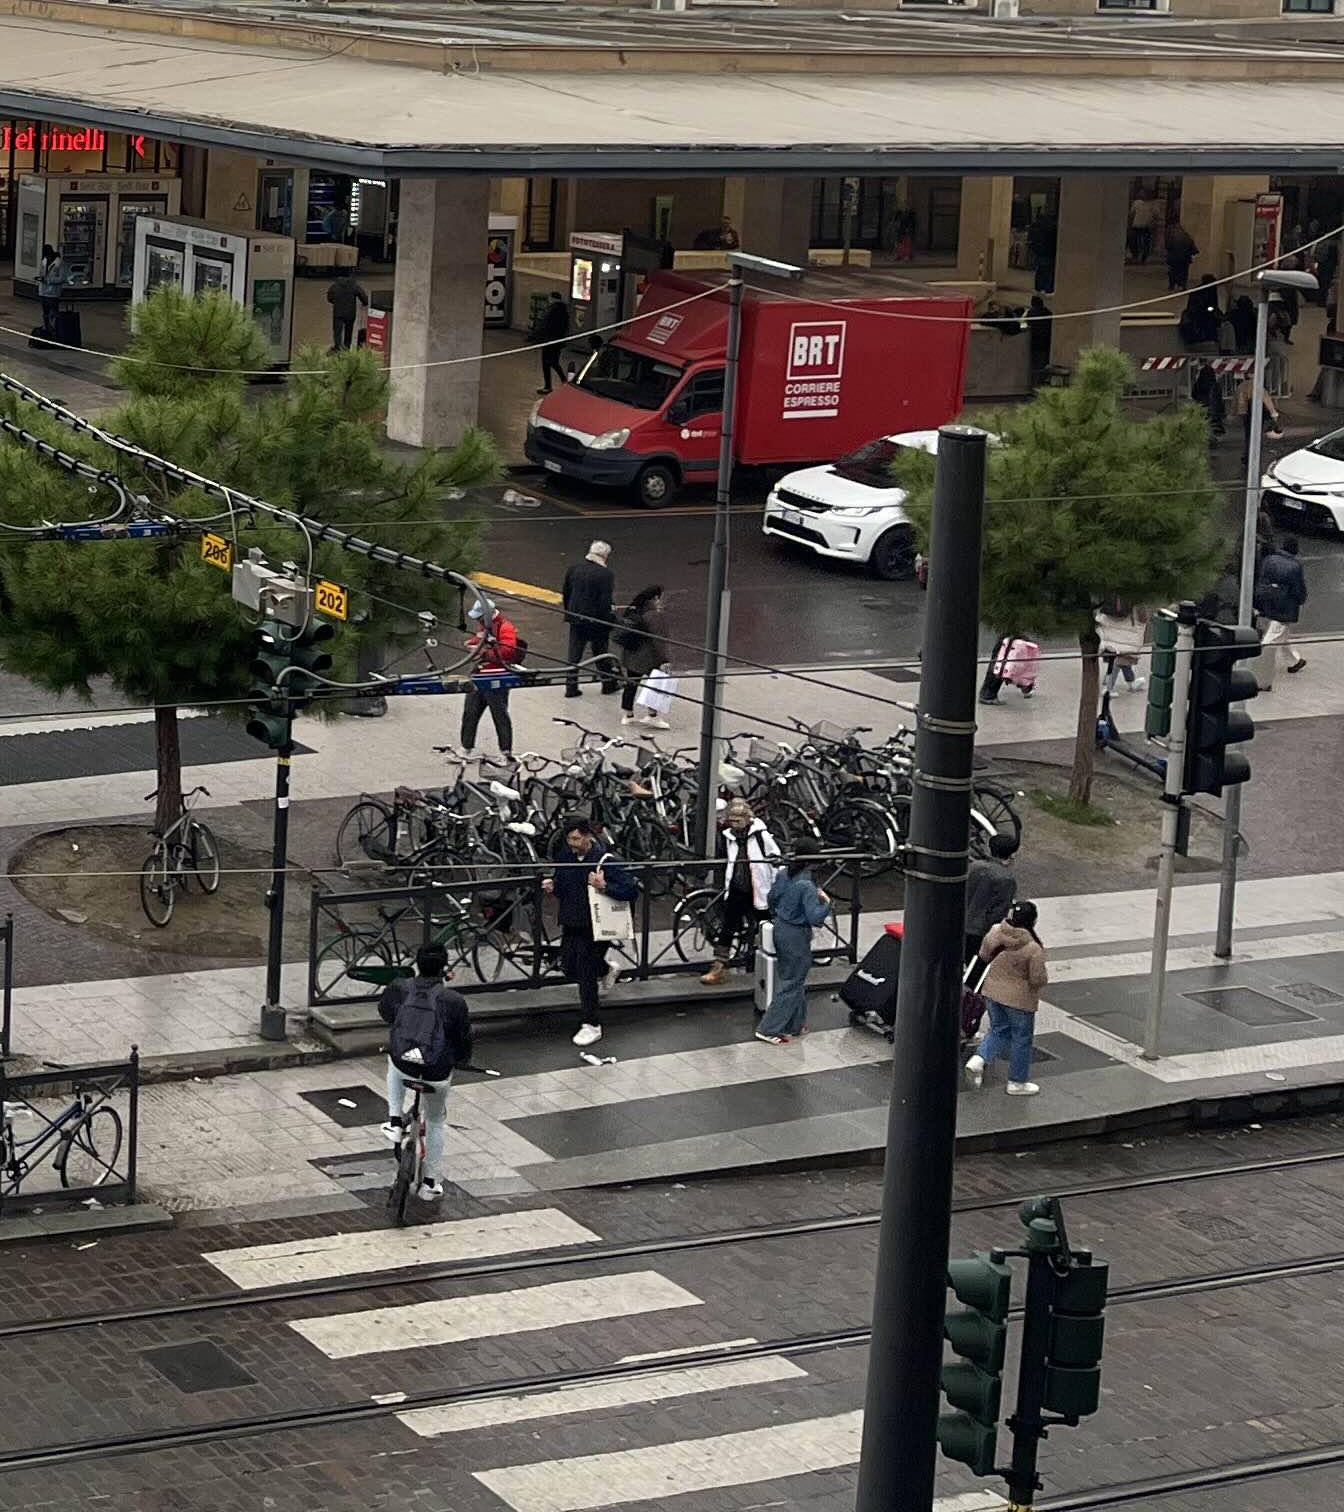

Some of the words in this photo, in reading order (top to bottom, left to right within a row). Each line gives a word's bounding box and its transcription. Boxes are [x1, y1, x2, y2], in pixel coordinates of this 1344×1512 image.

[1, 127, 105, 152] Felrinelli
[793, 335, 840, 366] BRT
[785, 381, 841, 395] CORRIERE
[783, 395, 840, 408] ESPRESSO
[205, 541, 228, 564] 206
[319, 589, 343, 614] 202
